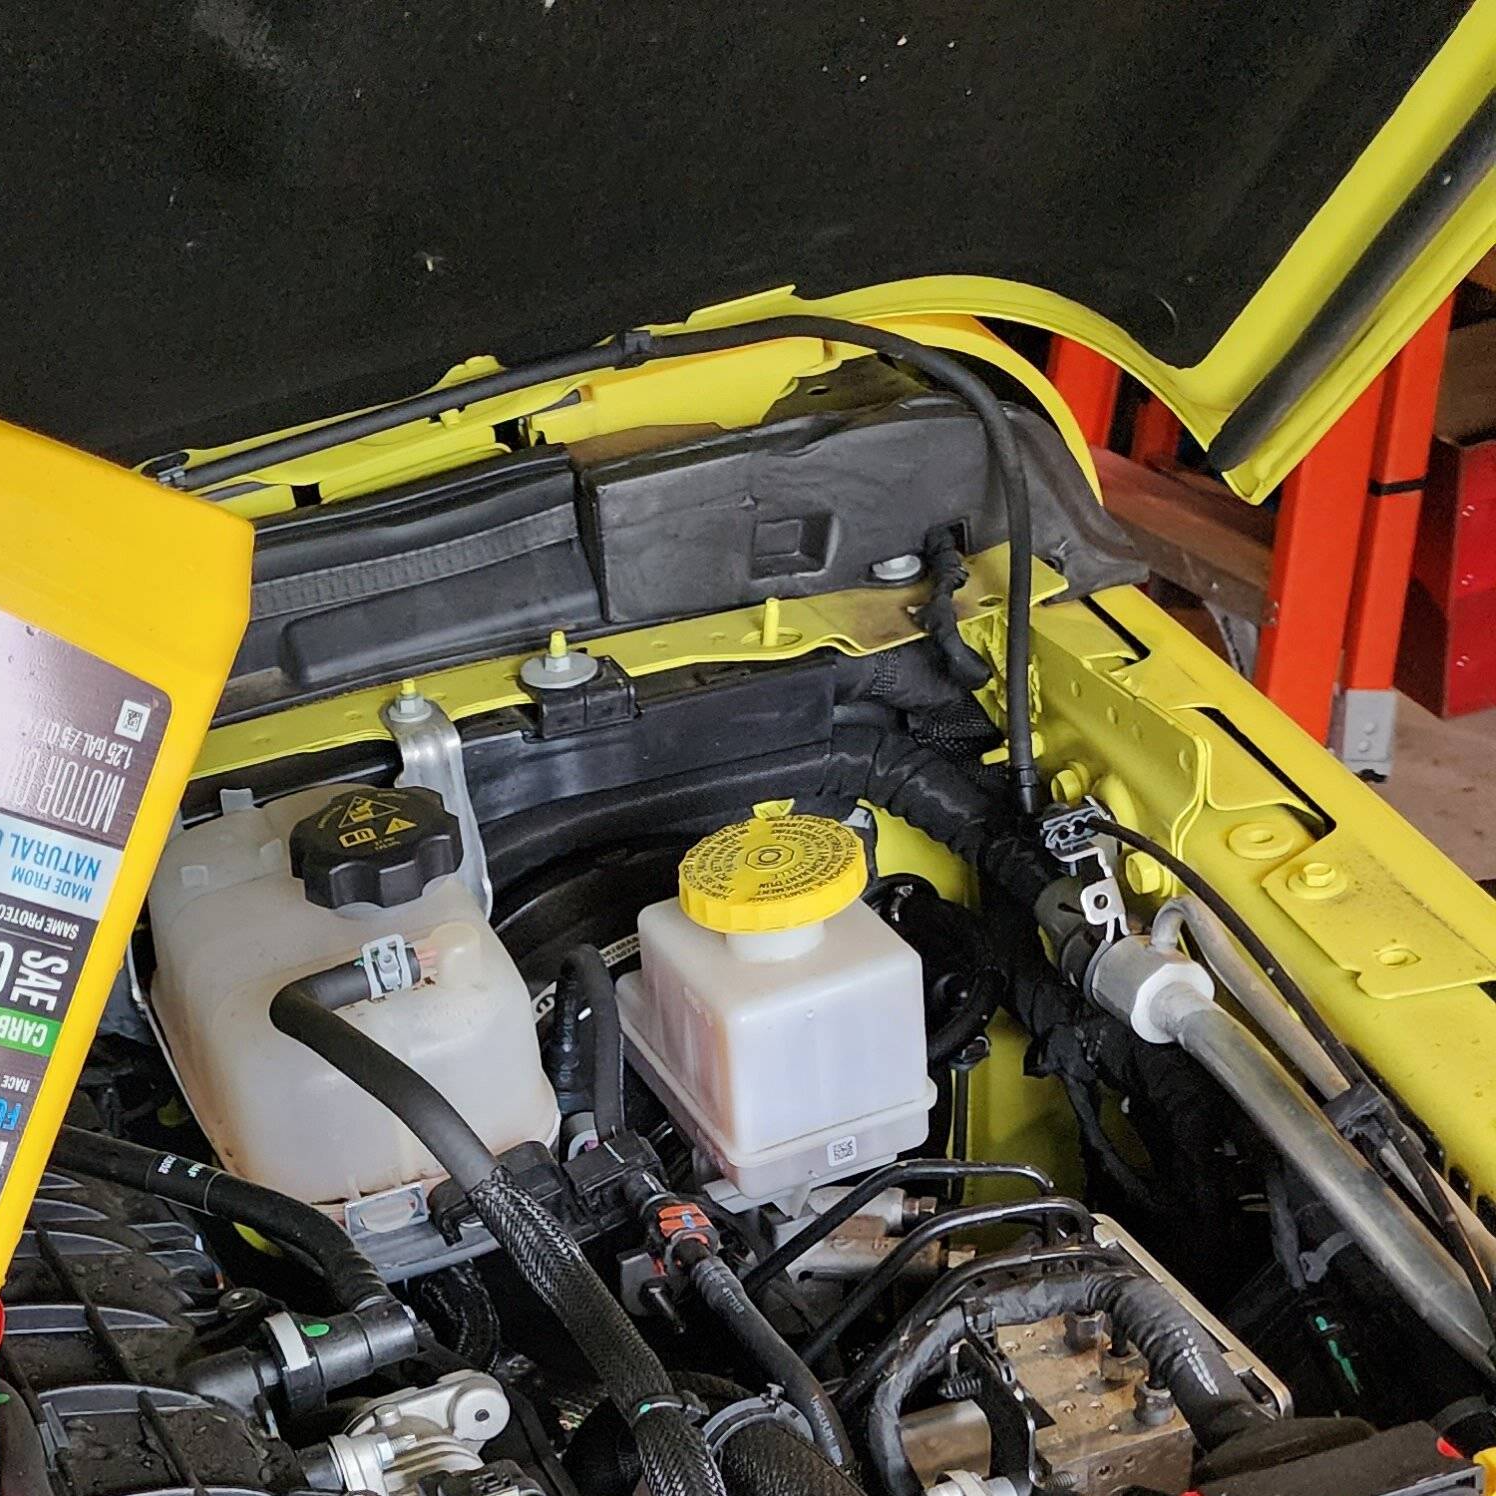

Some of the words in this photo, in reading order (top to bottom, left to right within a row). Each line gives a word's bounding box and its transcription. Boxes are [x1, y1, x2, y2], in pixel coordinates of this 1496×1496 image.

[37, 755, 126, 833] MOTOR
[11, 833, 102, 882] NATURAL
[11, 867, 49, 889] FROM
[52, 882, 93, 903] MADE
[45, 920, 79, 939] SAME
[10, 949, 70, 1012] SAE
[0, 1074, 30, 1093] RACE
